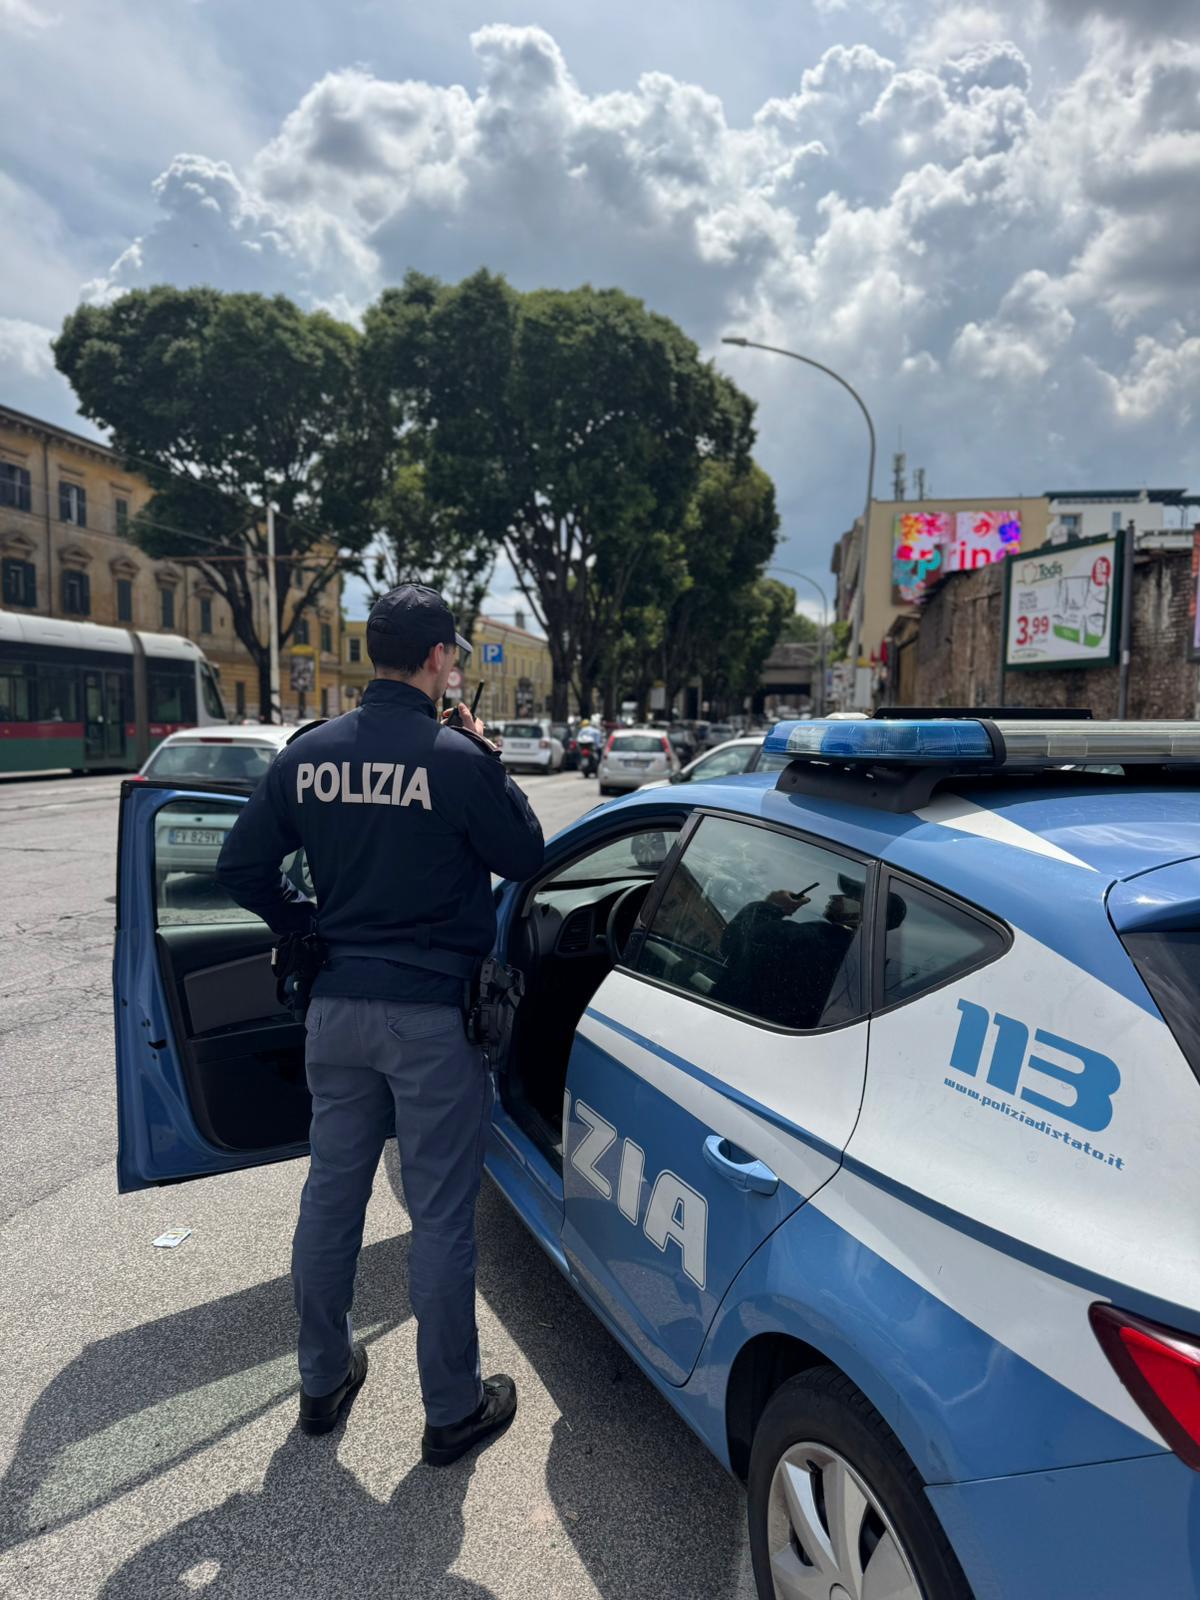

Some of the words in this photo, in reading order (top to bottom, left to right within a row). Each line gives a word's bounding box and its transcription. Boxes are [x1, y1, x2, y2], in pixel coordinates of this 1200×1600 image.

[487, 645, 499, 661] P
[1016, 615, 1050, 645] 3,99
[296, 761, 433, 811] POLIZIA
[949, 998, 1121, 1133] 113
[944, 1077, 1126, 1171] www.poliziadistato.it
